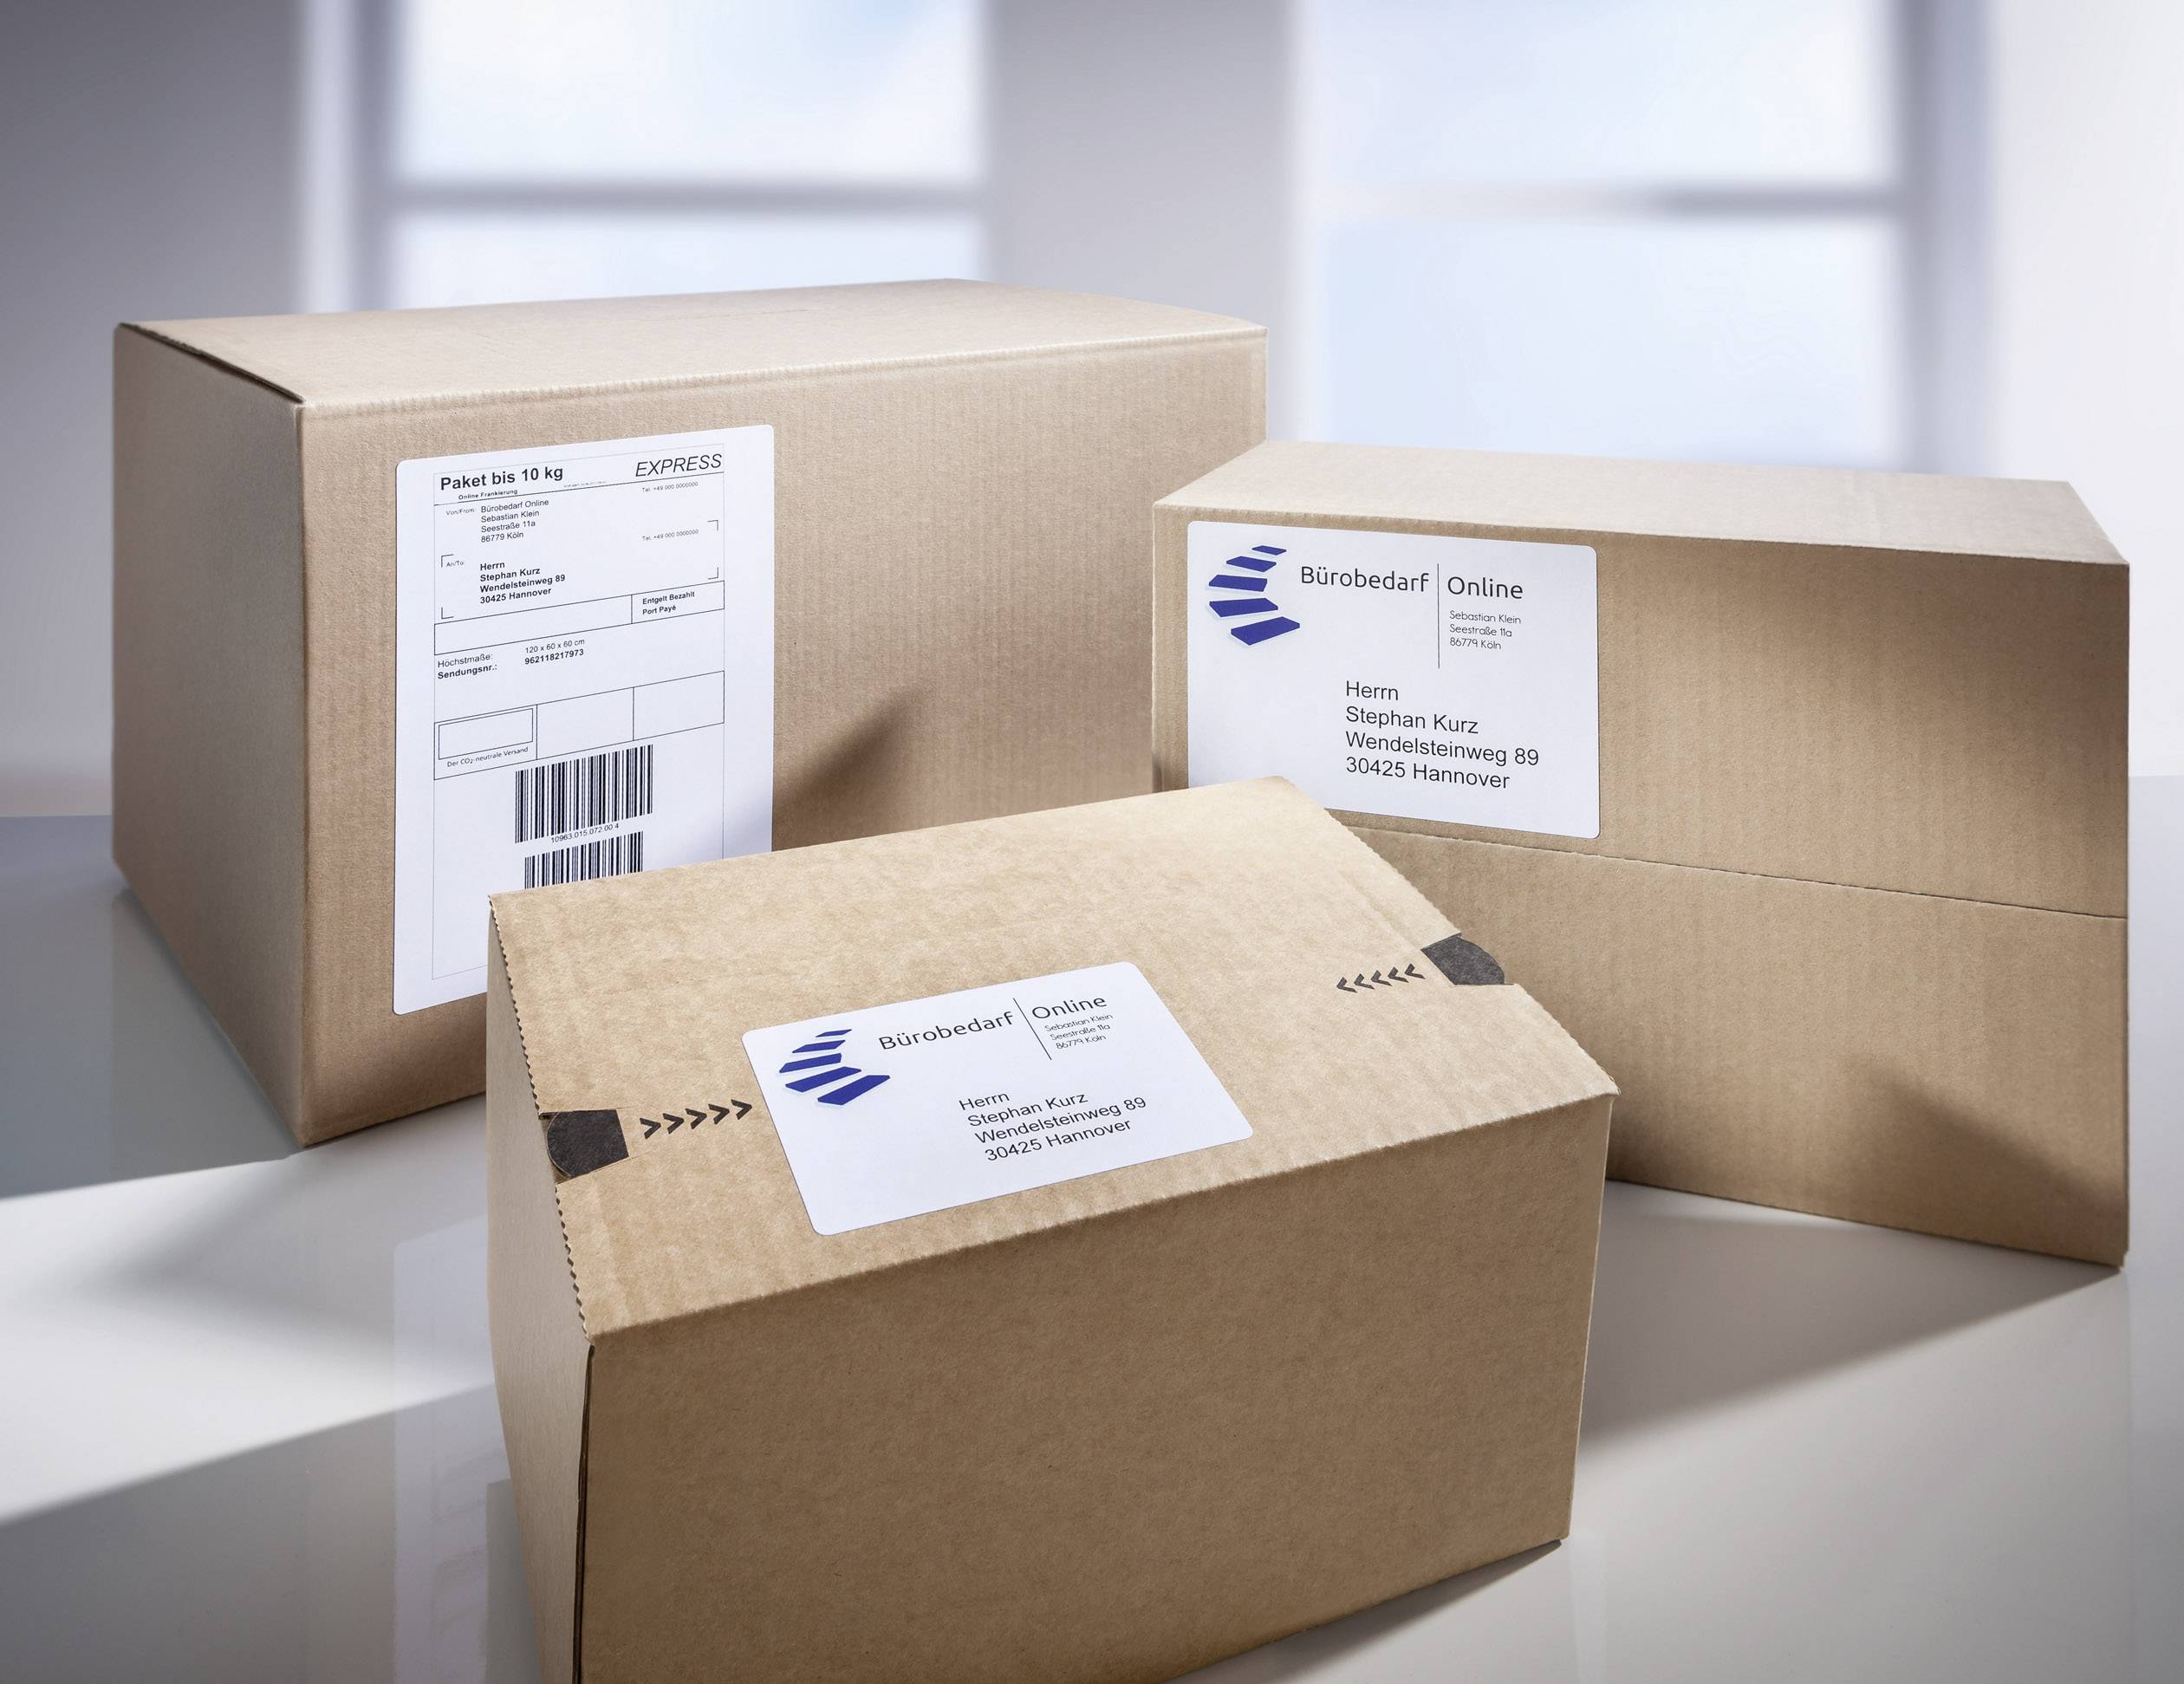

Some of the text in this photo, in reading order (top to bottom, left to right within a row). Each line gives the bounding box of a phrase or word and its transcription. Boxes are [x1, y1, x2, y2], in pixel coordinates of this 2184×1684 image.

[635, 453, 723, 477] EXPRESS
[440, 466, 563, 491] Paket bis 10 kg
[480, 488, 517, 498] Frankierung
[481, 499, 549, 513] Bürobedarf Online
[481, 510, 539, 523] Sebastian Klein
[481, 520, 536, 533] Seestraße 11a
[481, 531, 523, 543] 86779 Köln
[480, 561, 505, 570] Herrn
[480, 567, 540, 583] Stephan Kurz
[1300, 565, 1524, 599] Bürobedarf Online
[480, 574, 566, 593] Wendelsteinweg 89
[480, 588, 551, 604] 30425 Hannover
[642, 591, 695, 606] Entgelt Bezahlt
[660, 604, 676, 614] Payé
[1449, 610, 1521, 624] Sebastian Klein
[1449, 624, 1512, 637] Seestraße 11a
[1449, 637, 1502, 650] 86779 Köln
[524, 649, 584, 665] 962118217973
[438, 663, 497, 679] Sendungsnr.:
[1346, 680, 1399, 700] Herrn
[1346, 705, 1479, 734] Stephan Kurz
[504, 747, 528, 756] Versand
[1346, 731, 1539, 766] Wendelsteinweg 89
[1347, 757, 1510, 789] 30425 Hannover
[878, 995, 1108, 1050] Bürobedarf Online
[1044, 1014, 1113, 1031] Sebastian Klein
[1050, 1027, 1096, 1040] Seestraße
[1056, 1035, 1106, 1049] 86779 Köln
[959, 1093, 1010, 1110] Herrn
[968, 1093, 1088, 1127] Stephan Kurz
[975, 1096, 1147, 1144] Wendelsteinweg 89
[985, 1119, 1131, 1161] 30425 Hannover
